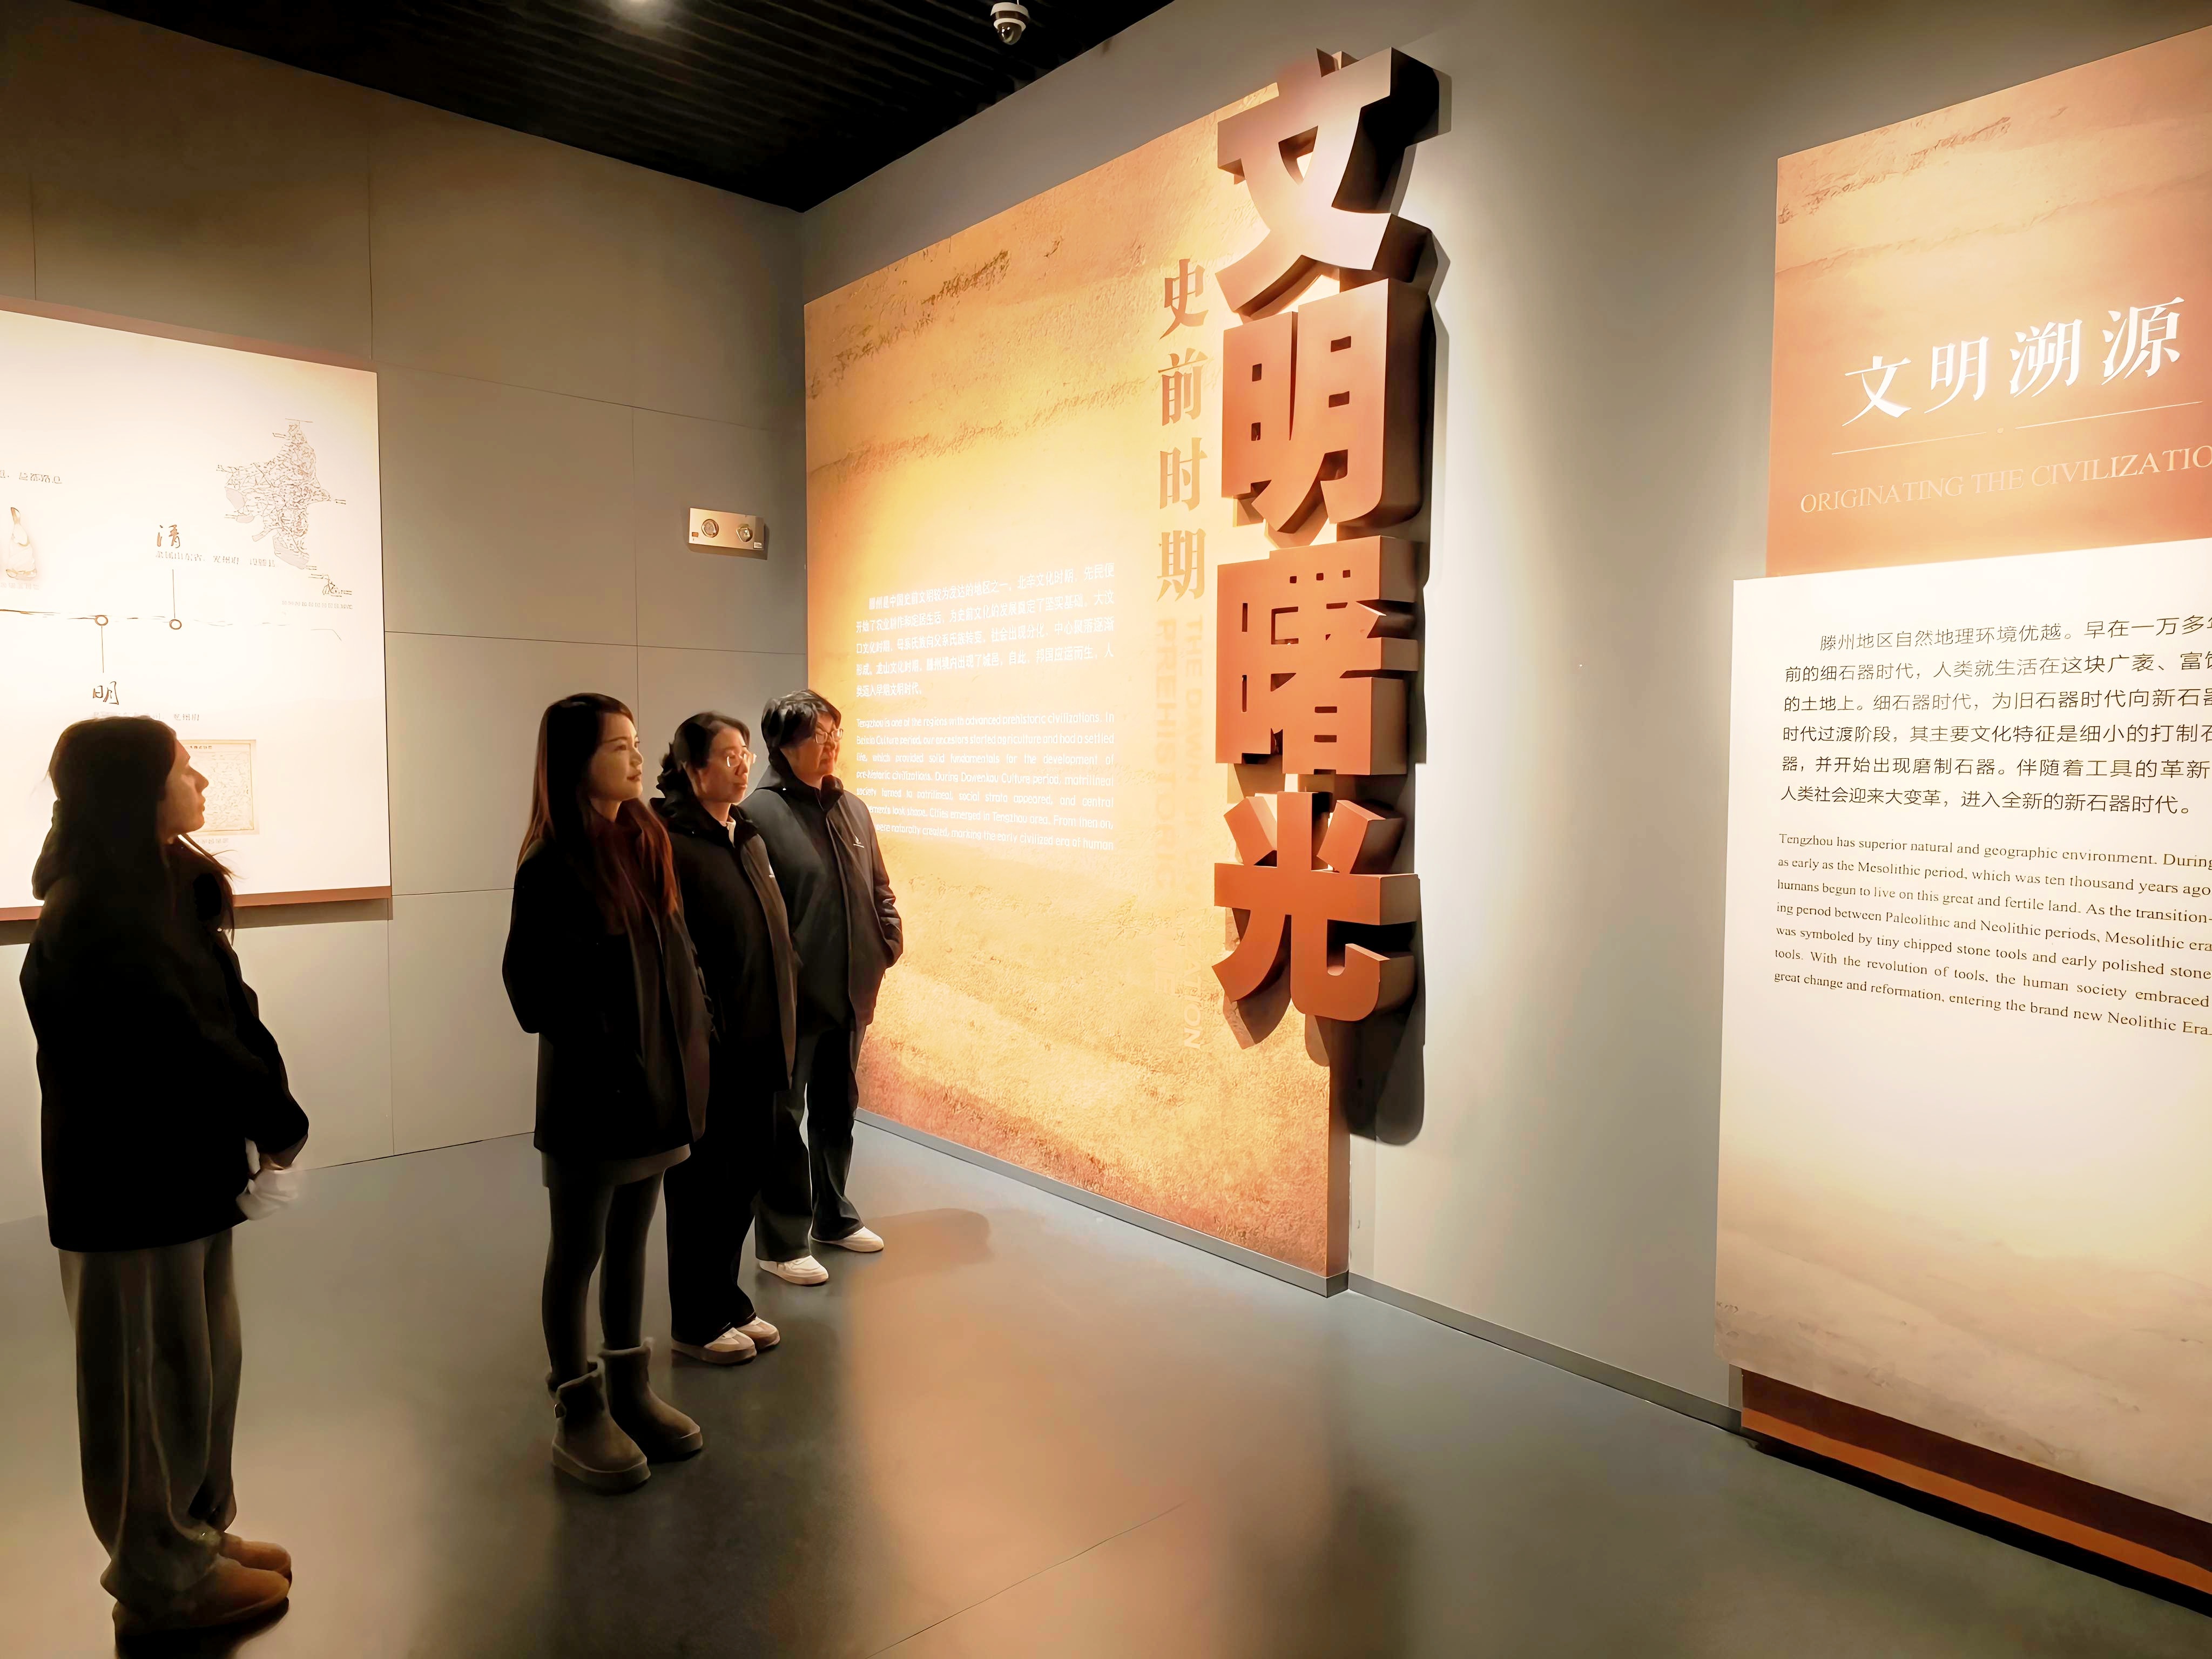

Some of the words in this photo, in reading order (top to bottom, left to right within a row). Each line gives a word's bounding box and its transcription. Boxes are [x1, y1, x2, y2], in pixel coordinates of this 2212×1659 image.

[1842, 296, 2185, 427] 文明溯源
[1156, 258, 1208, 601] 史前时期
[1800, 475, 1965, 514] ORIGINATING
[1971, 467, 2024, 494] THE
[1212, 48, 1399, 1021] 文明曙光
[92, 680, 120, 705] 明
[998, 734, 1041, 745] agriculture
[1043, 734, 1058, 743] and
[1060, 734, 1076, 743] had
[1084, 733, 1115, 743] settled
[935, 772, 958, 782] During
[1001, 773, 1030, 783] Culture
[1033, 774, 1061, 785] period,
[1007, 754, 1017, 763] for
[1024, 754, 1036, 764] the
[1043, 754, 1097, 765] development
[1105, 754, 1114, 765] of
[959, 792, 979, 801] social
[1014, 794, 1053, 805] appeared,
[1060, 795, 1076, 806] and
[1082, 797, 1114, 807] central
[950, 811, 981, 821] emerged
[983, 812, 990, 820] in
[1054, 815, 1076, 826] From
[1080, 817, 1097, 828] then
[1100, 820, 1113, 830] on,
[984, 830, 995, 840] the
[997, 832, 1017, 842] early
[1020, 833, 1053, 845] civilized
[1056, 838, 1069, 846] era
[1073, 838, 1081, 847] of
[1083, 838, 1114, 850] human
[1779, 834, 1832, 846] Tengzhou
[1837, 837, 1855, 847] has
[1859, 839, 1907, 851] superior
[1911, 842, 1952, 853] natural
[1957, 844, 1979, 854] and
[1984, 847, 2057, 860] geographic
[2062, 849, 2157, 864] environment.
[1792, 859, 1819, 871] early
[1838, 860, 1853, 871] the
[1858, 862, 1920, 875] Mesolithic
[1925, 867, 1967, 879] period,
[1972, 870, 2009, 881] which
[2015, 875, 2040, 884] was
[2046, 876, 2064, 885] ten
[2071, 876, 2134, 890] thousand
[2139, 883, 2177, 894] years
[1778, 879, 1819, 892] humans
[1823, 883, 1855, 896] begun
[1874, 887, 1895, 898] live
[1918, 891, 1938, 901] this
[1943, 896, 1973, 905] great
[1978, 896, 2000, 906] and
[2006, 896, 2044, 909] fertile
[2049, 900, 2081, 913] land.
[2086, 904, 2105, 914] As
[2110, 905, 2131, 916] the
[2136, 909, 2212, 923] transition-
[1777, 902, 1793, 915] ing
[1797, 907, 1830, 916] period
[1835, 907, 1881, 921] between
[1886, 912, 1950, 927] Paleolithic
[1954, 920, 1975, 929] and
[1981, 920, 2040, 935] Neolithic
[2046, 928, 2100, 942] periods,
[2106, 932, 2184, 948] Mesolithic
[2189, 942, 2212, 951] era
[1776, 928, 1796, 936] was
[1800, 930, 1853, 942] symboled
[1859, 933, 1872, 946] by
[1878, 935, 1899, 949] tiny
[1904, 938, 1951, 953] chipped
[1957, 946, 1990, 956] stone
[1997, 949, 2027, 960] tools
[2033, 953, 2056, 963] and
[2062, 956, 2096, 970] early
[2103, 959, 2163, 974] polished
[2170, 968, 2211, 979] stone
[1776, 949, 1803, 960] tools.
[1811, 952, 1836, 963] With
[1844, 956, 1860, 966] the
[1867, 961, 1927, 974] revolution
[1935, 967, 1949, 976] of
[1997, 973, 2015, 984] the
[2024, 975, 2068, 991] human
[2077, 984, 2127, 1000] society
[2136, 990, 2209, 1007] embraced
[1775, 974, 1799, 983] great
[1804, 975, 1843, 989] change
[1847, 981, 1866, 991] and
[1871, 984, 1944, 1002] reformation,
[1950, 996, 2001, 1011] entering
[2006, 1000, 2025, 1011] the
[2031, 1002, 2068, 1017] brand
[2074, 1011, 2102, 1021] new
[2108, 1012, 2176, 1030] Neolithic
[2183, 1021, 2212, 1035] Era.
